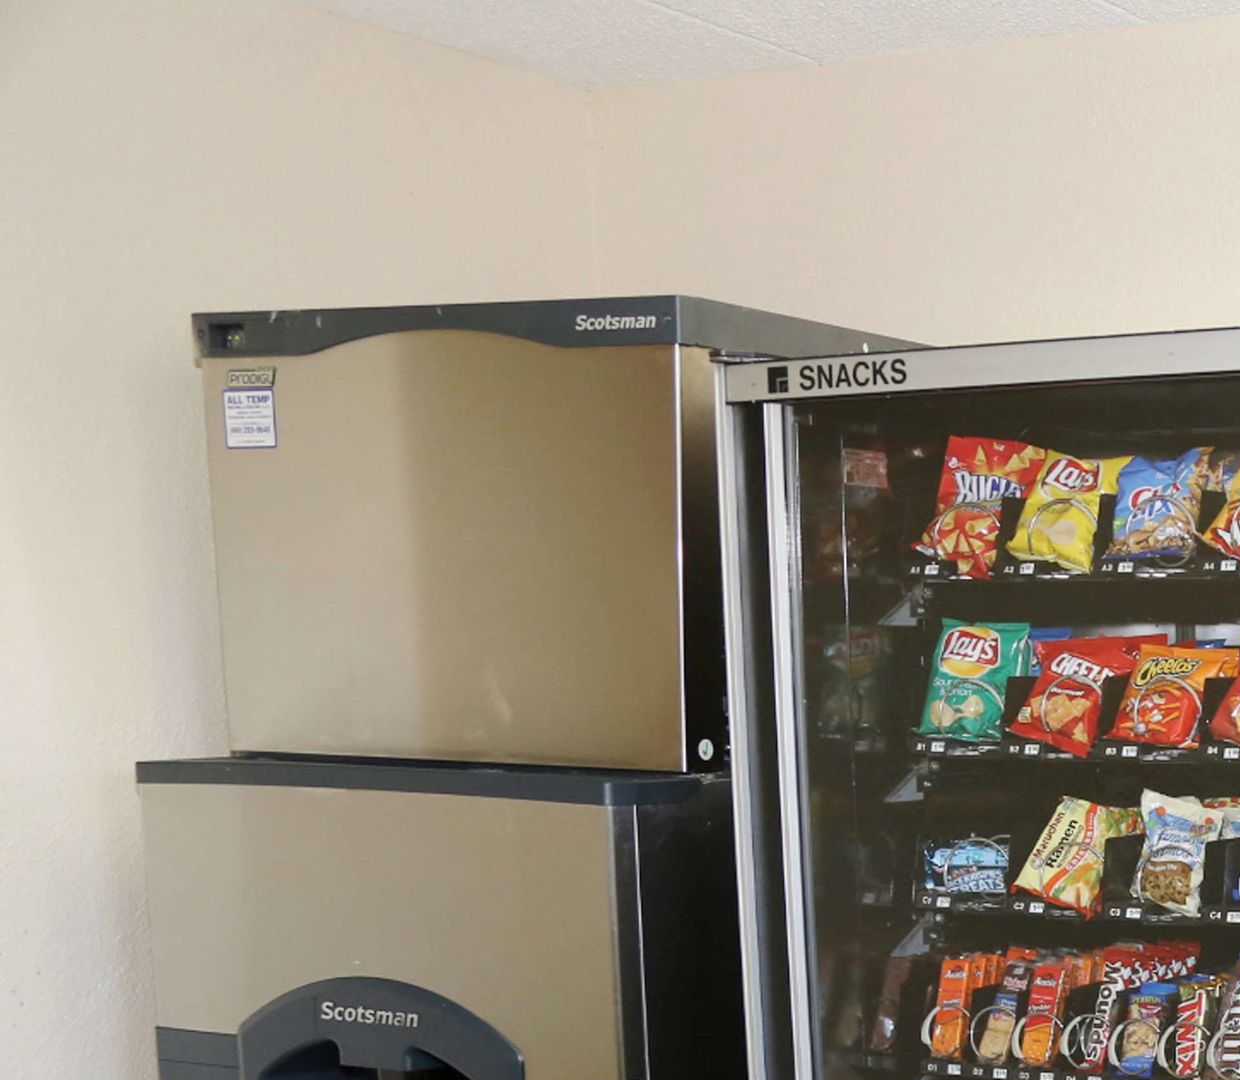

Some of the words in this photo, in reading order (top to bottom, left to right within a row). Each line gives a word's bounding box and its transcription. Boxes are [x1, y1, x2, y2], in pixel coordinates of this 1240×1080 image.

[575, 314, 656, 330] Scotsman
[799, 359, 908, 391] SNACKS
[943, 631, 998, 664] Lay's
[1135, 656, 1202, 687] Cheetos
[1033, 812, 1066, 859] Maruchan
[1045, 819, 1079, 870] Ramen
[320, 1001, 419, 1028] Scotsman
[1086, 961, 1124, 1060] Mounds
[1176, 989, 1205, 1077] TWIX
